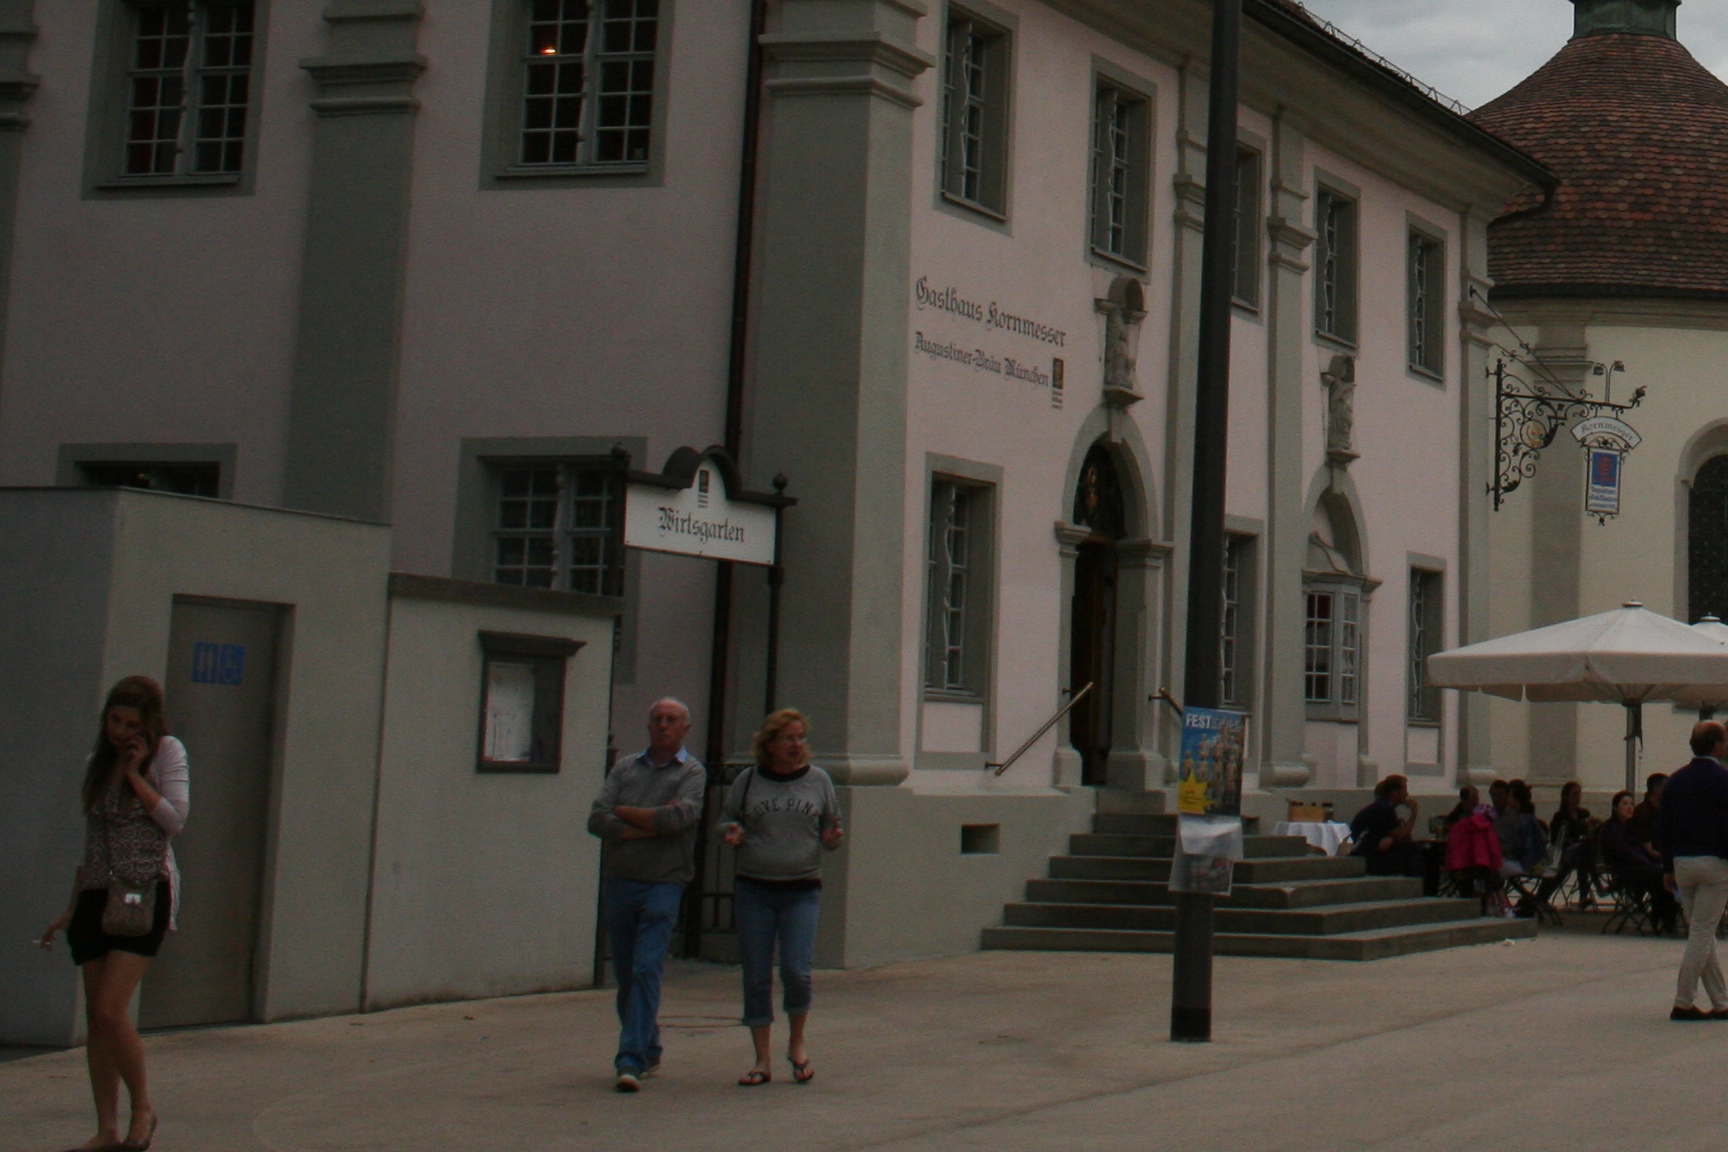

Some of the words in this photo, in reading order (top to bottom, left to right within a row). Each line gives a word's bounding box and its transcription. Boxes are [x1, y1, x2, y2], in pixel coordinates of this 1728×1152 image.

[915, 275, 983, 322] Gasthaus
[987, 301, 1067, 348] Kornmesser
[1004, 357, 1049, 387] München
[657, 505, 745, 544] Wirtsgarten
